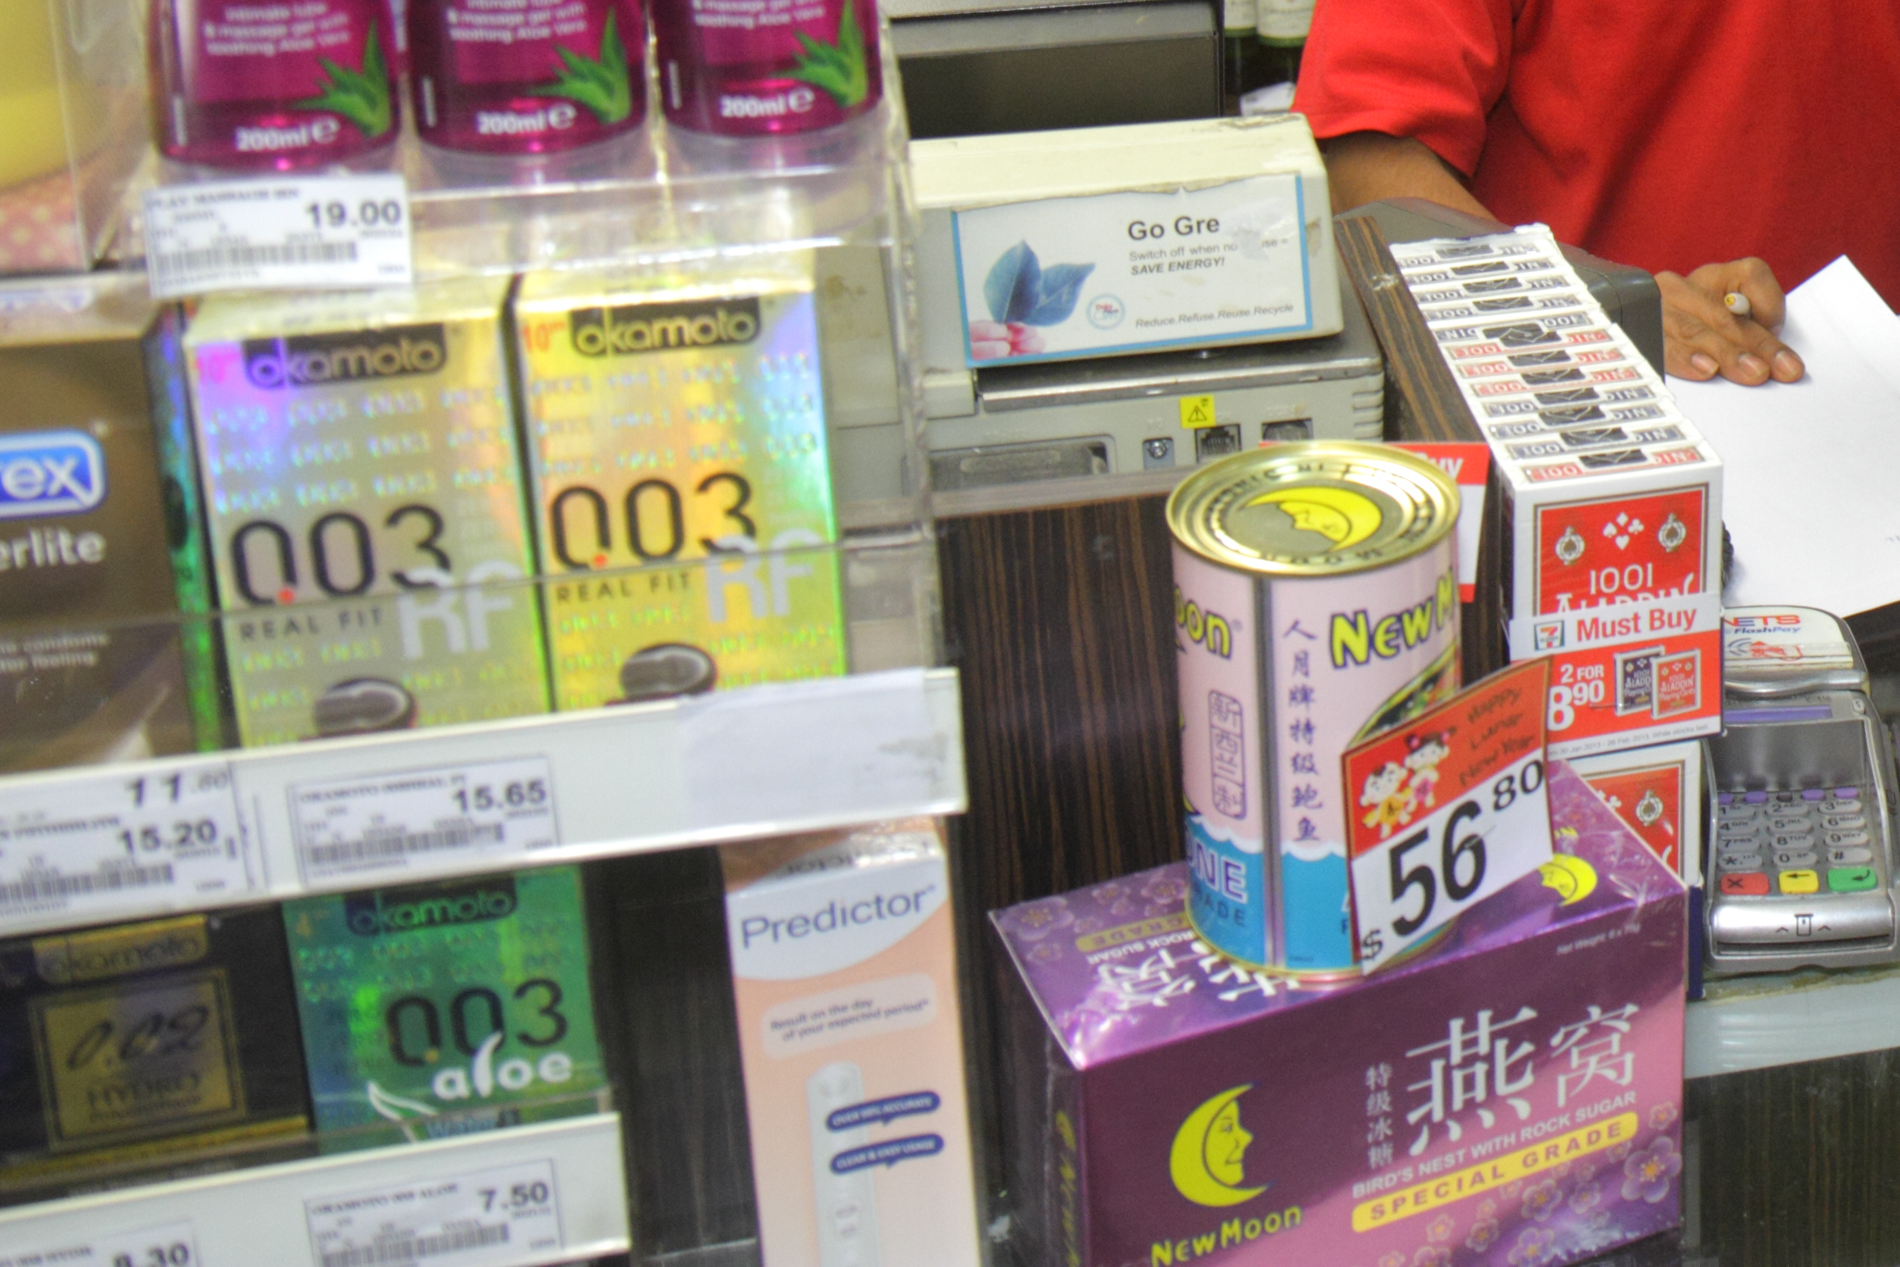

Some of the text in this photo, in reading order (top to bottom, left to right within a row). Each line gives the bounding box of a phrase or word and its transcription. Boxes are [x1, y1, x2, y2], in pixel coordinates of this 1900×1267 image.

[478, 108, 546, 135] 200ml
[720, 96, 786, 119] 200ml
[235, 125, 308, 151] 200ml
[307, 202, 402, 228] 19.00
[1128, 219, 1165, 241] Go
[1130, 244, 1221, 263] Switch off when
[1131, 256, 1226, 277] SAVE ENERGY!
[576, 307, 756, 357] okamoto
[249, 338, 443, 389] okamoto
[556, 573, 692, 604] REAL FIT
[1590, 563, 1654, 595] 1001
[1577, 607, 1698, 642] Must Buy
[1560, 663, 1605, 683] 2 FOR
[452, 779, 546, 815] 15.65
[1493, 760, 1544, 816] 80
[118, 819, 217, 855] 15.20
[741, 886, 927, 950] Predictor
[432, 1034, 572, 1101] aloe
[1405, 1002, 1639, 1158] 燕窝
[1366, 1062, 1395, 1171] 特级冰糖
[1353, 1091, 1637, 1198] BIRD'S NEST WITH ROCK SUGAR
[1370, 1119, 1626, 1224] SPECIAL GRADE
[478, 1181, 549, 1213] 7.50
